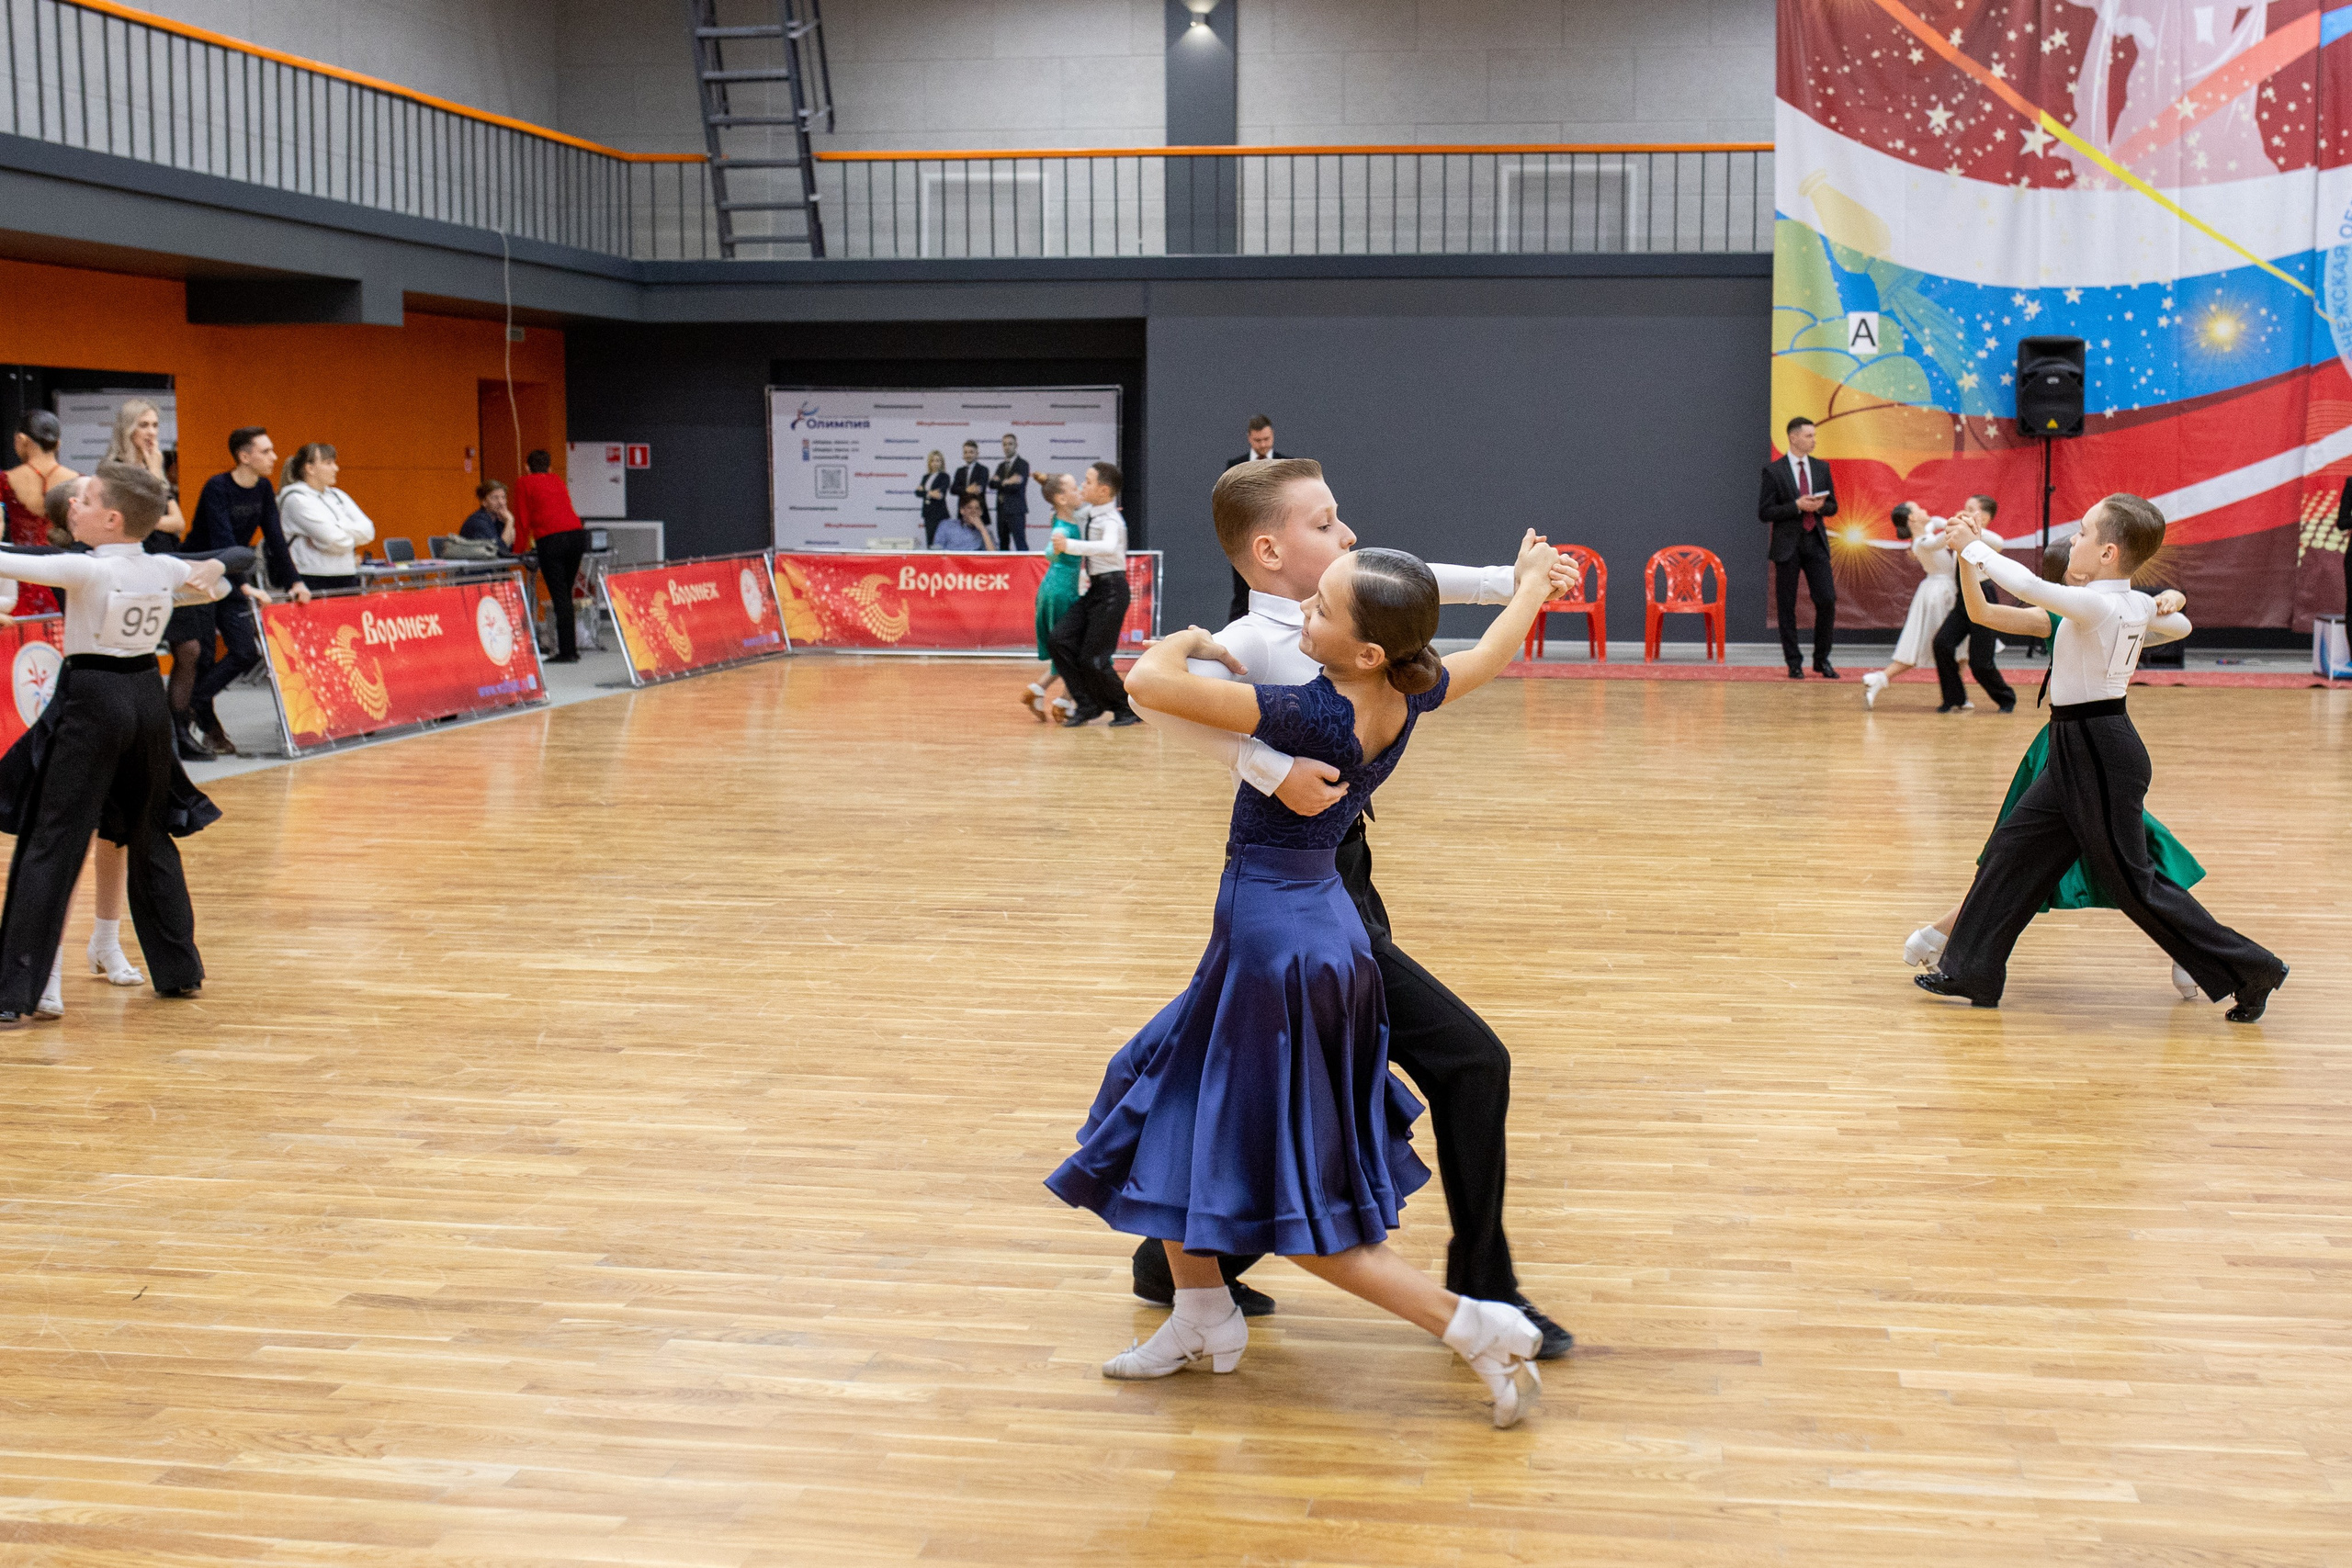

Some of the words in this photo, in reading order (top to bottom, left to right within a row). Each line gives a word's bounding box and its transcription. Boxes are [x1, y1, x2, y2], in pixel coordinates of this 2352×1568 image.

[807, 417, 870, 429] Олимпия
[898, 565, 1010, 598] Воронеж
[121, 606, 162, 637] 95
[361, 610, 444, 652] Воронеж
